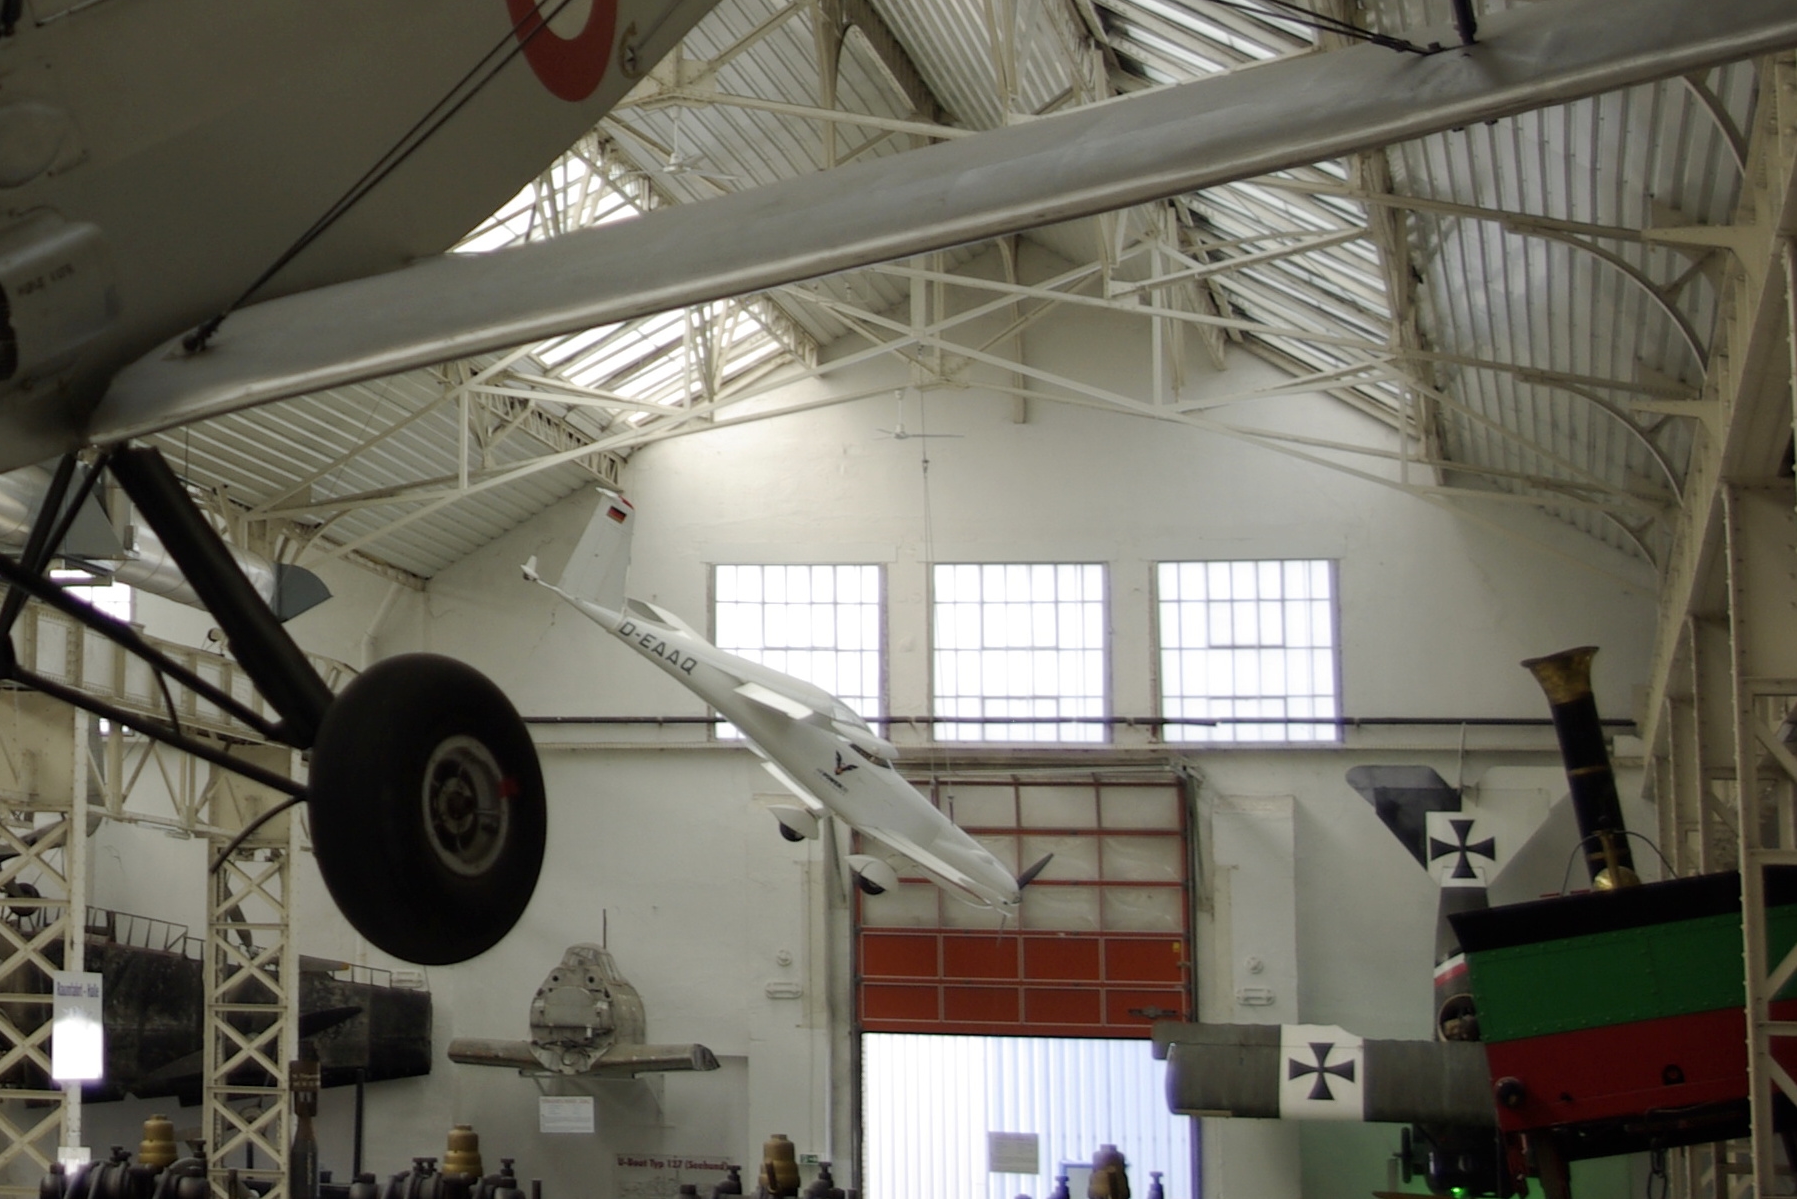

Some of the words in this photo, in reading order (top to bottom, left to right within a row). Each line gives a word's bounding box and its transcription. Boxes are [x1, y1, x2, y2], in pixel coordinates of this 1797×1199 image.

[617, 620, 698, 676] D-EAAQ
[617, 1156, 647, 1168] U-Boot
[649, 1157, 664, 1170] Typ
